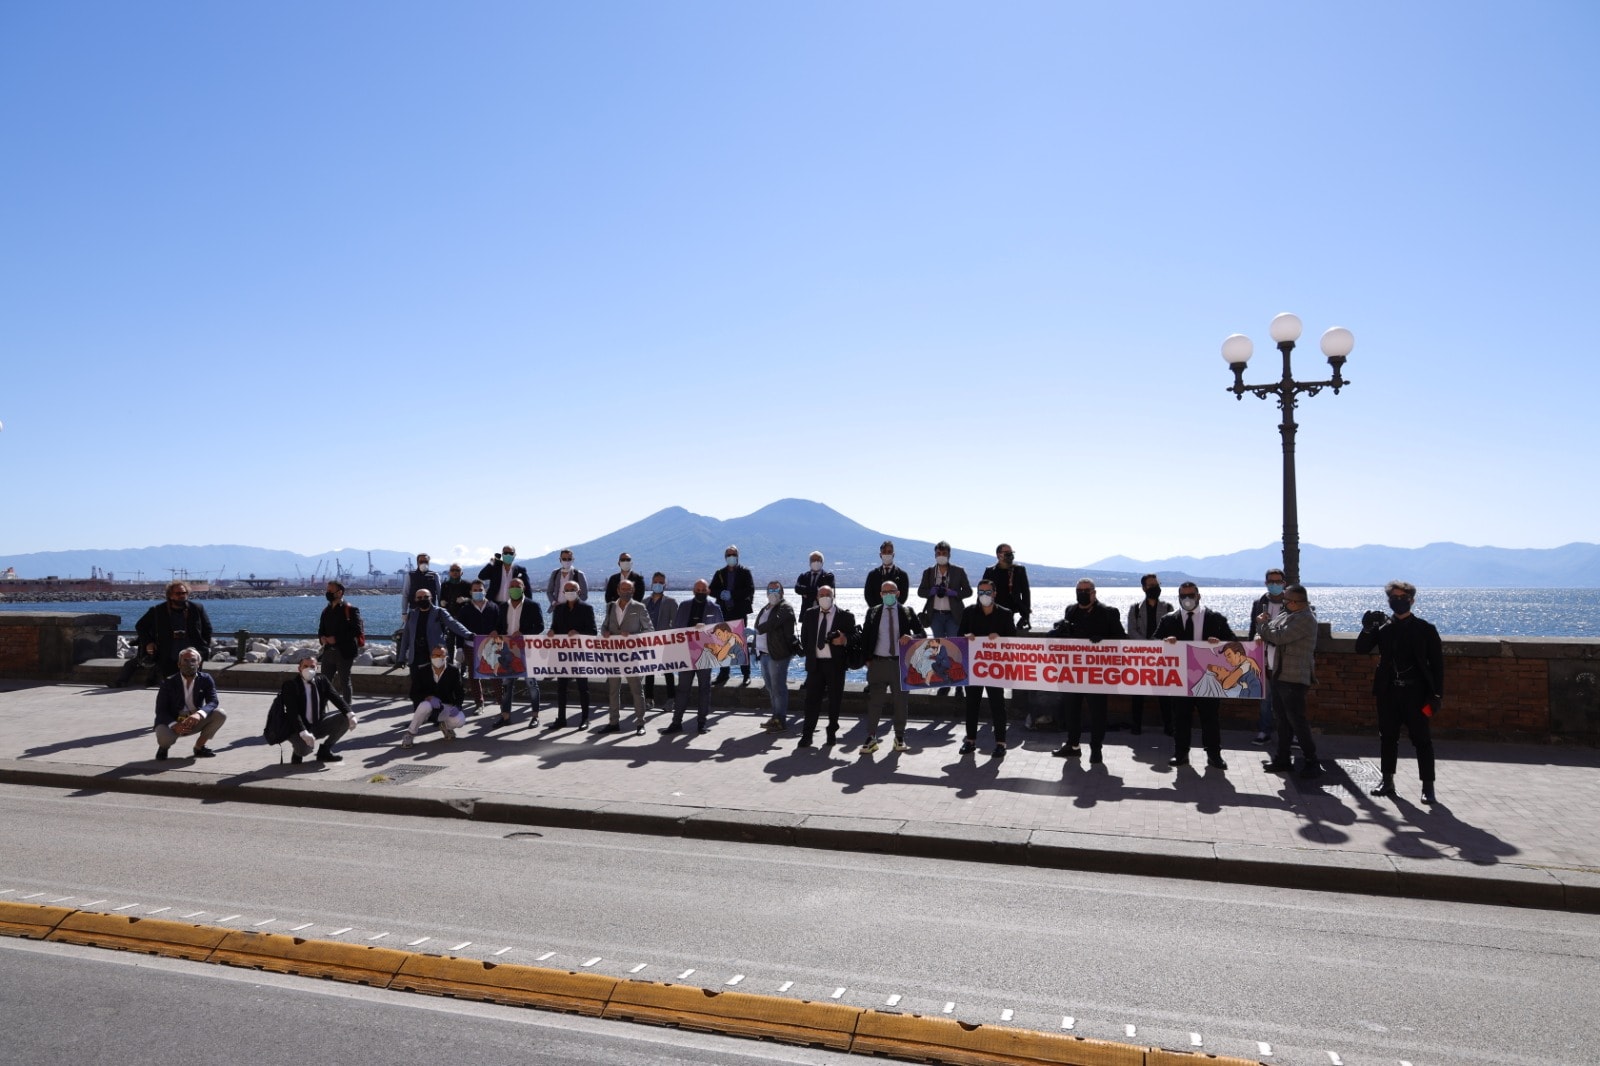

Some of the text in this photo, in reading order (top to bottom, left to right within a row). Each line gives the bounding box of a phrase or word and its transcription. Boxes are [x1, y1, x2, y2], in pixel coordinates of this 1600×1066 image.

[509, 630, 701, 650] FOTOGRAFI CERIMONIALISTI
[982, 642, 1163, 654] NOI FOTOGRAFI CERIMONIALISTI CAMPANI
[558, 649, 656, 663] DIMENTICATI
[974, 650, 1180, 667] ABBANDONATI E DIMENTICATI
[533, 660, 689, 675] DALLA REGIONE CAMPANIA
[973, 661, 1184, 687] COME CATEGORIA
